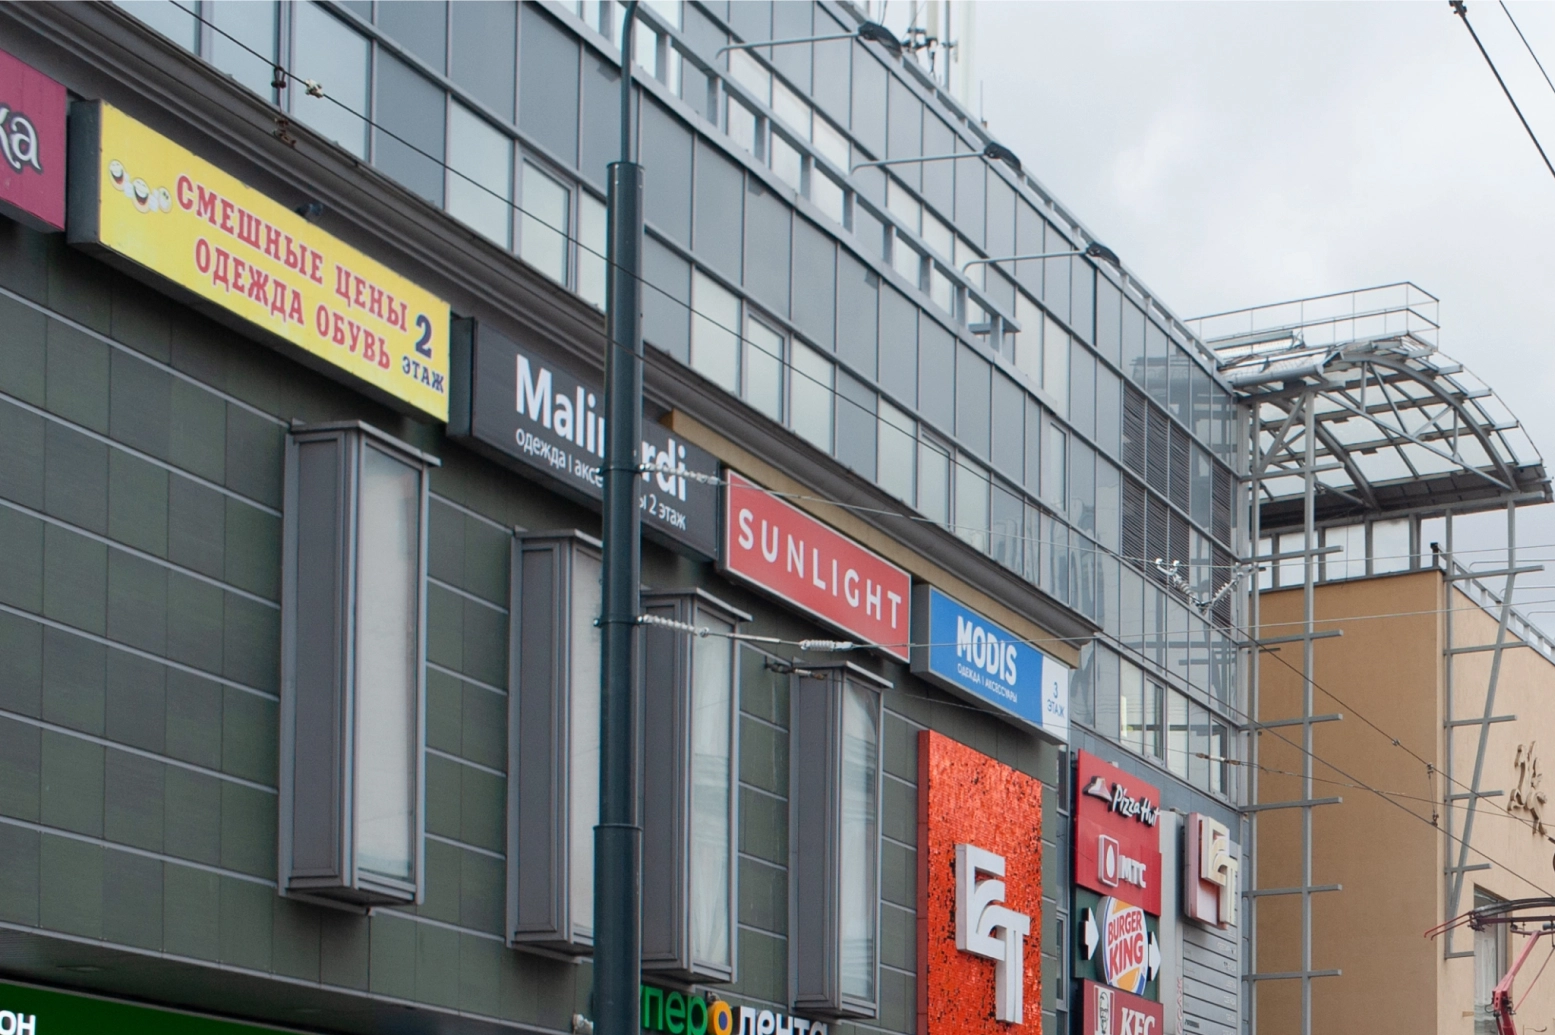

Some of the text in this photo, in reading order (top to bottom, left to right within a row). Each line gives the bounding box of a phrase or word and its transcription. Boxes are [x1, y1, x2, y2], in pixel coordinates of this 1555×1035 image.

[175, 175, 408, 333] СМЕШНЫЕ ЦЕНЫ
[195, 238, 391, 371] ОДЕЖДА ОБУВЬ
[414, 314, 433, 359] 2
[402, 355, 445, 394] ЭТАЖ
[515, 428, 566, 469] одежда
[649, 493, 657, 516] 2
[659, 503, 687, 531] этаж
[738, 508, 902, 629] SUNLIGHT
[957, 615, 1018, 686] MODIS
[957, 663, 981, 685] ОДЕЖДА
[1046, 699, 1066, 719] ЭТАЖ
[1112, 784, 1160, 827] Pizza Hut
[1118, 855, 1147, 888] МТС
[1108, 911, 1142, 948] BURGER
[1109, 932, 1144, 980] KING
